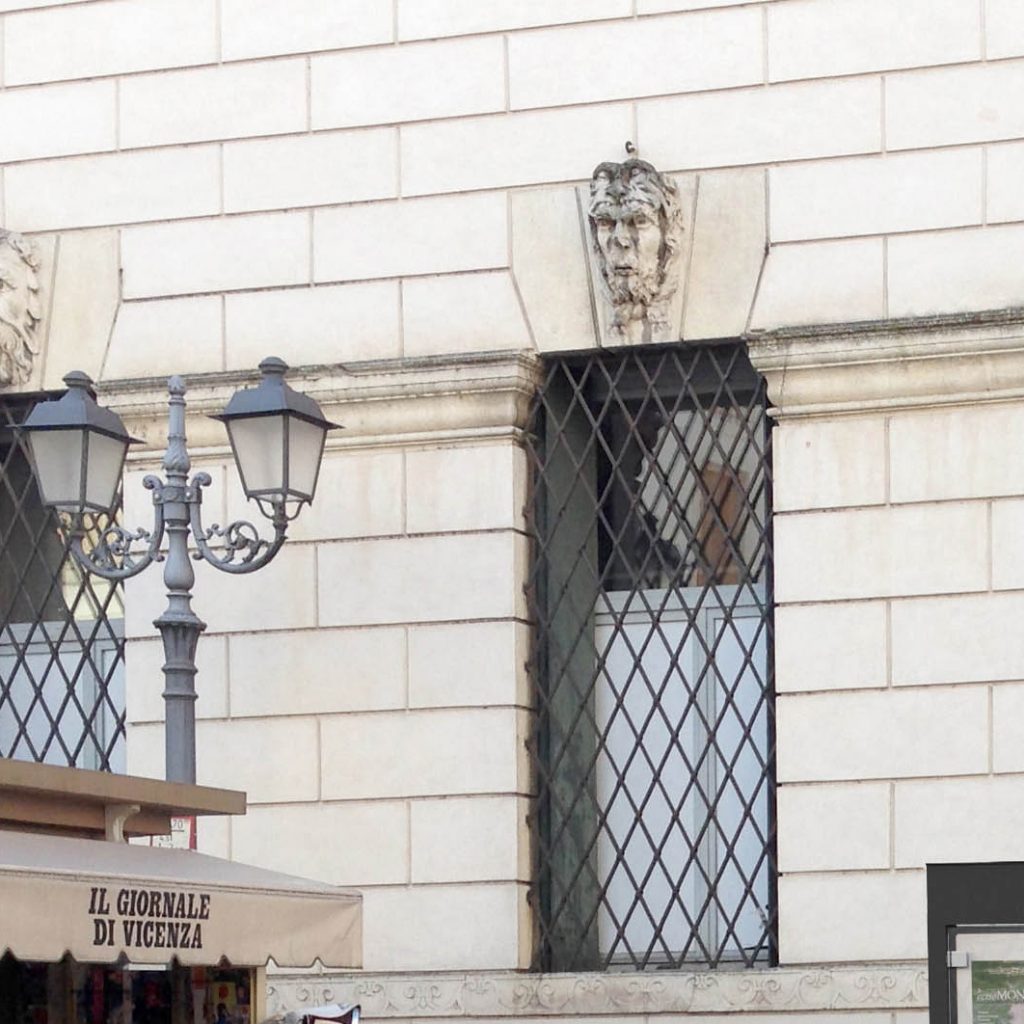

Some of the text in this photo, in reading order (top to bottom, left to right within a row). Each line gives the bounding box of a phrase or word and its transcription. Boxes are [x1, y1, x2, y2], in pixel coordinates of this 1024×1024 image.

[88, 887, 210, 920] IL GIORNALE
[93, 918, 203, 949] DI VICENZA
